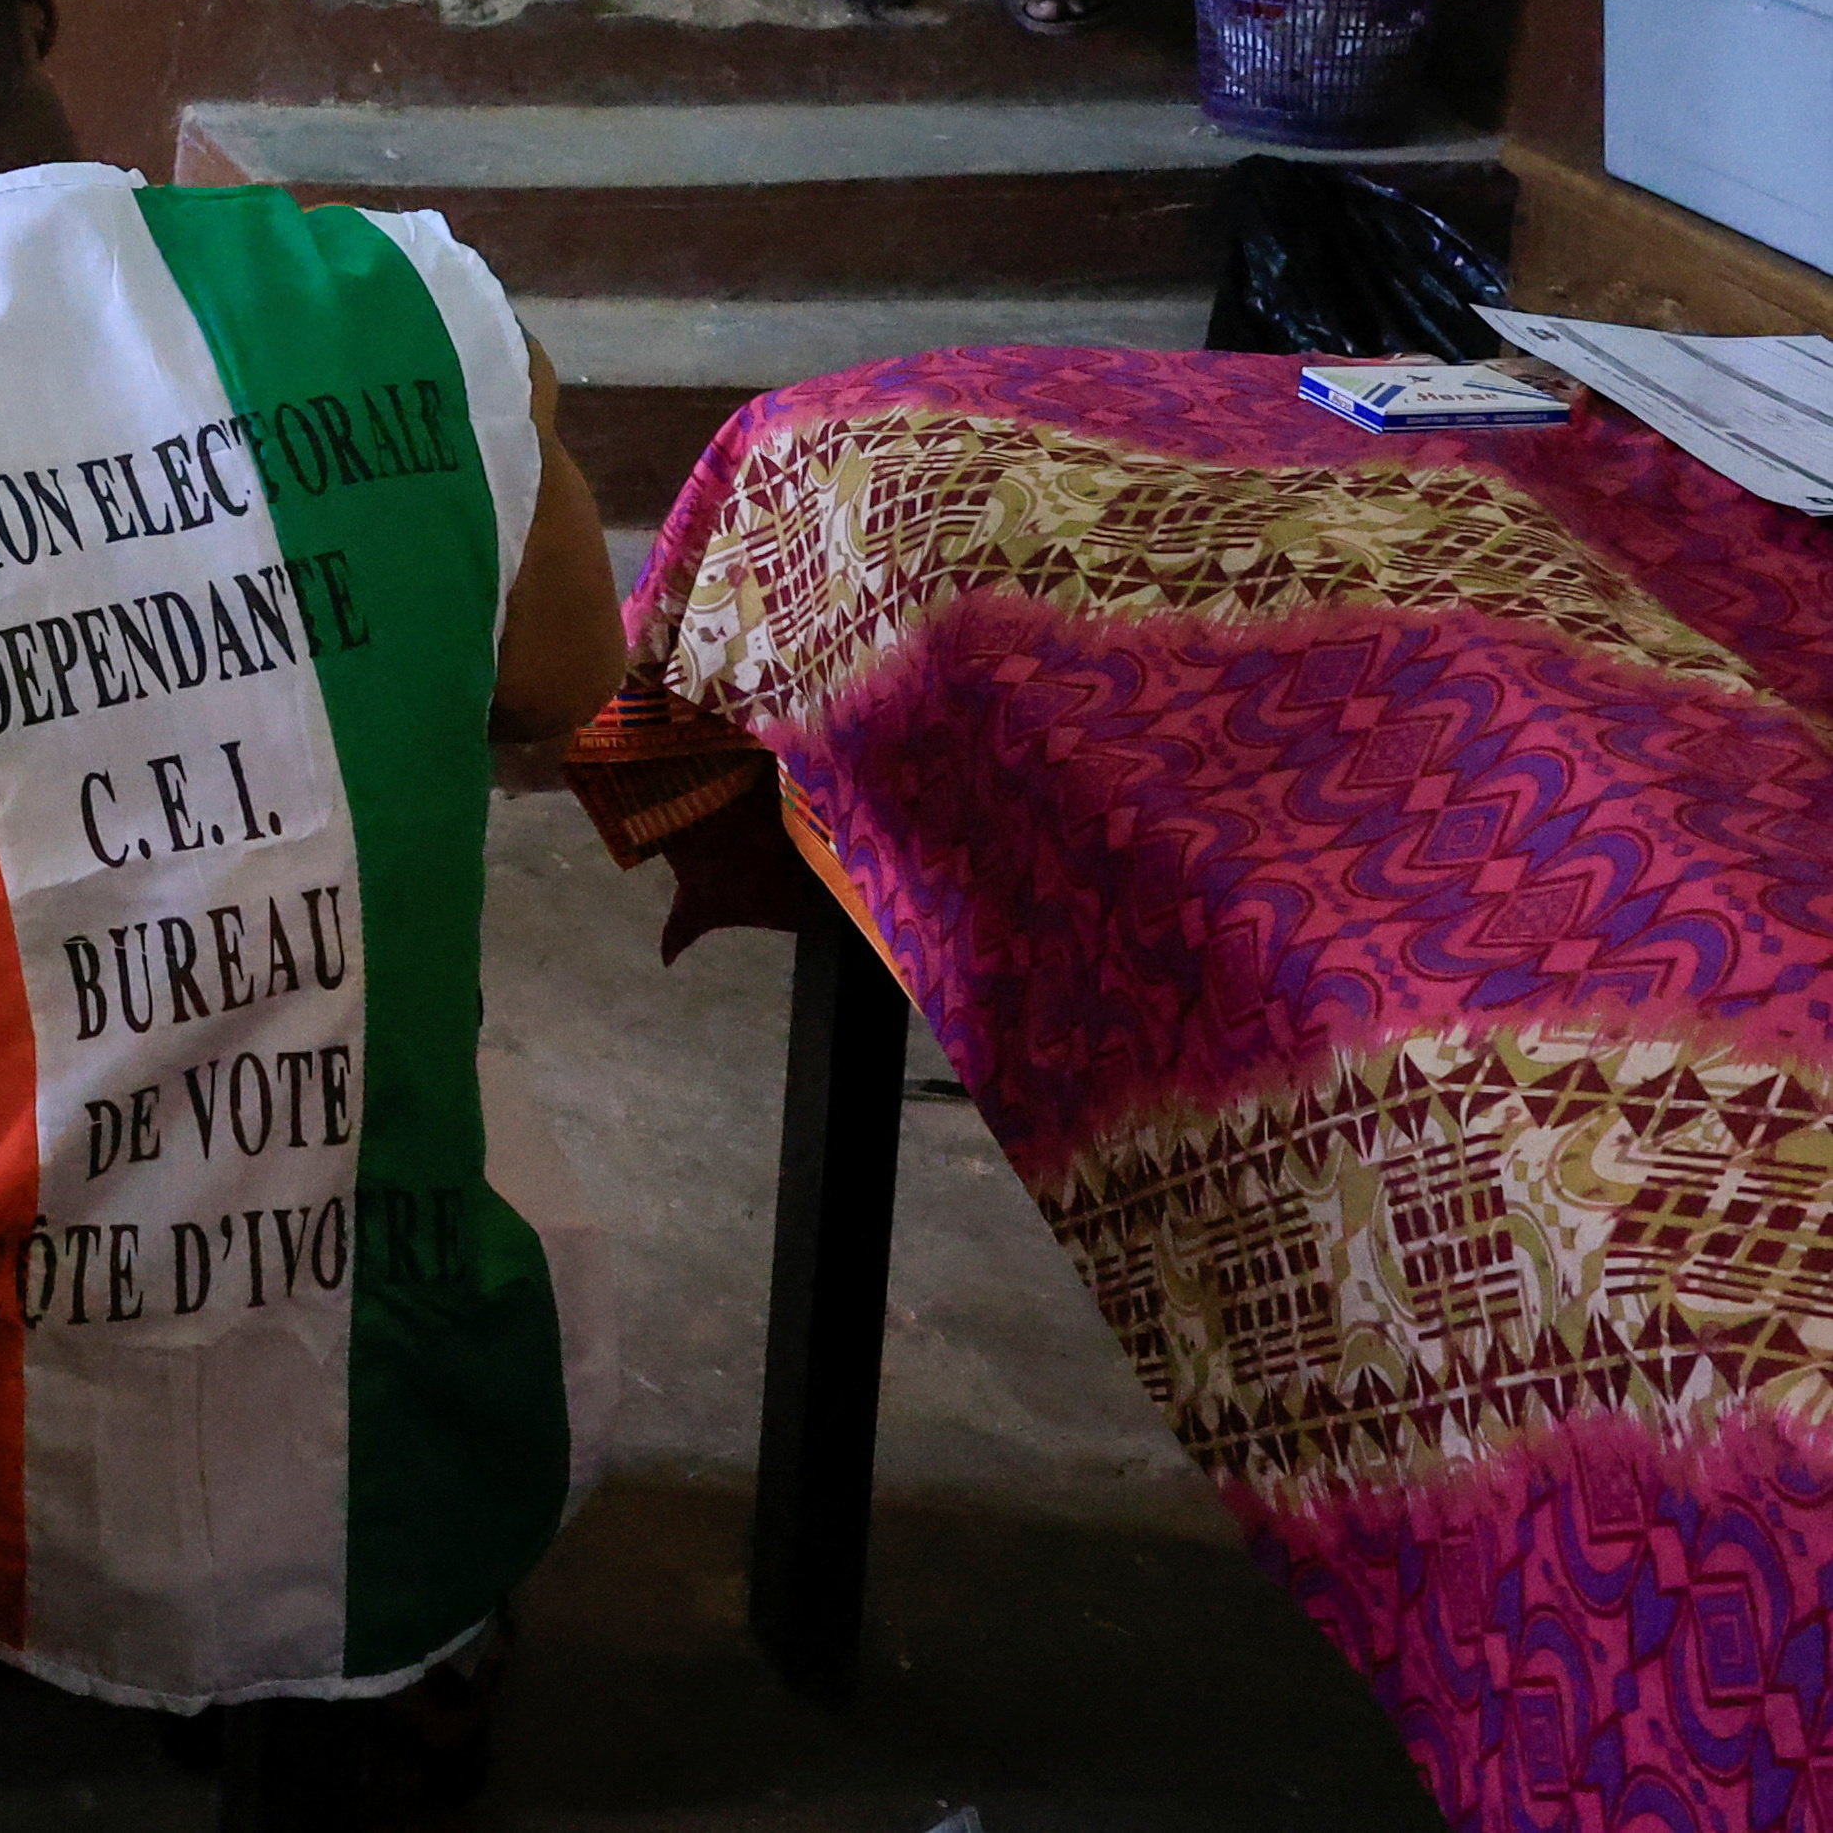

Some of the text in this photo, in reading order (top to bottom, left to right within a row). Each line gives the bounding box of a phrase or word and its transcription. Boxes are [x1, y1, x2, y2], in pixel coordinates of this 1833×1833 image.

[76, 378, 461, 546] ELECTORALE
[80, 740, 282, 870] C.E.I.
[64, 884, 348, 1042] BUREAU
[84, 1045, 352, 1184] DE VOTE
